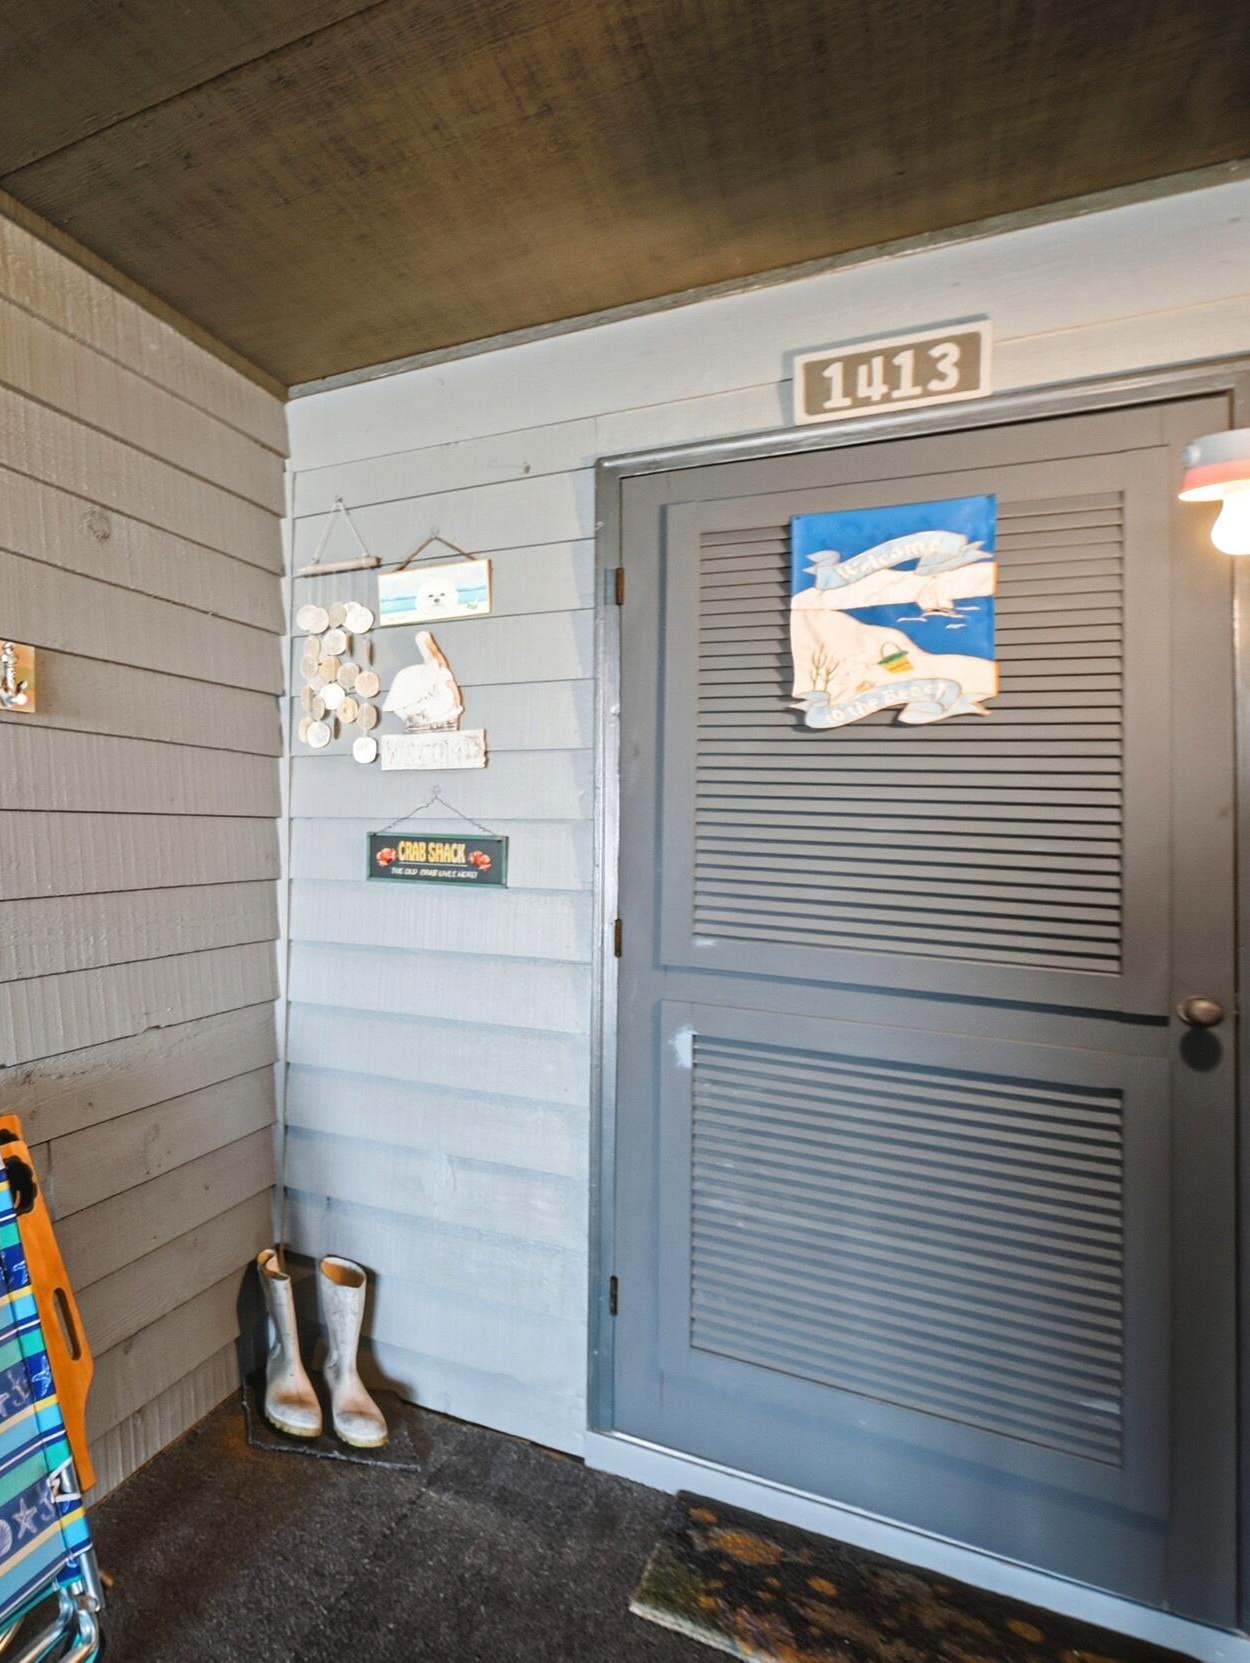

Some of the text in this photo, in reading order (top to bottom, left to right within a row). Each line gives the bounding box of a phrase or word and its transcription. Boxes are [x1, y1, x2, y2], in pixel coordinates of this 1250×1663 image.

[822, 342, 961, 409] 1413
[398, 840, 466, 864] CRAB SHACK
